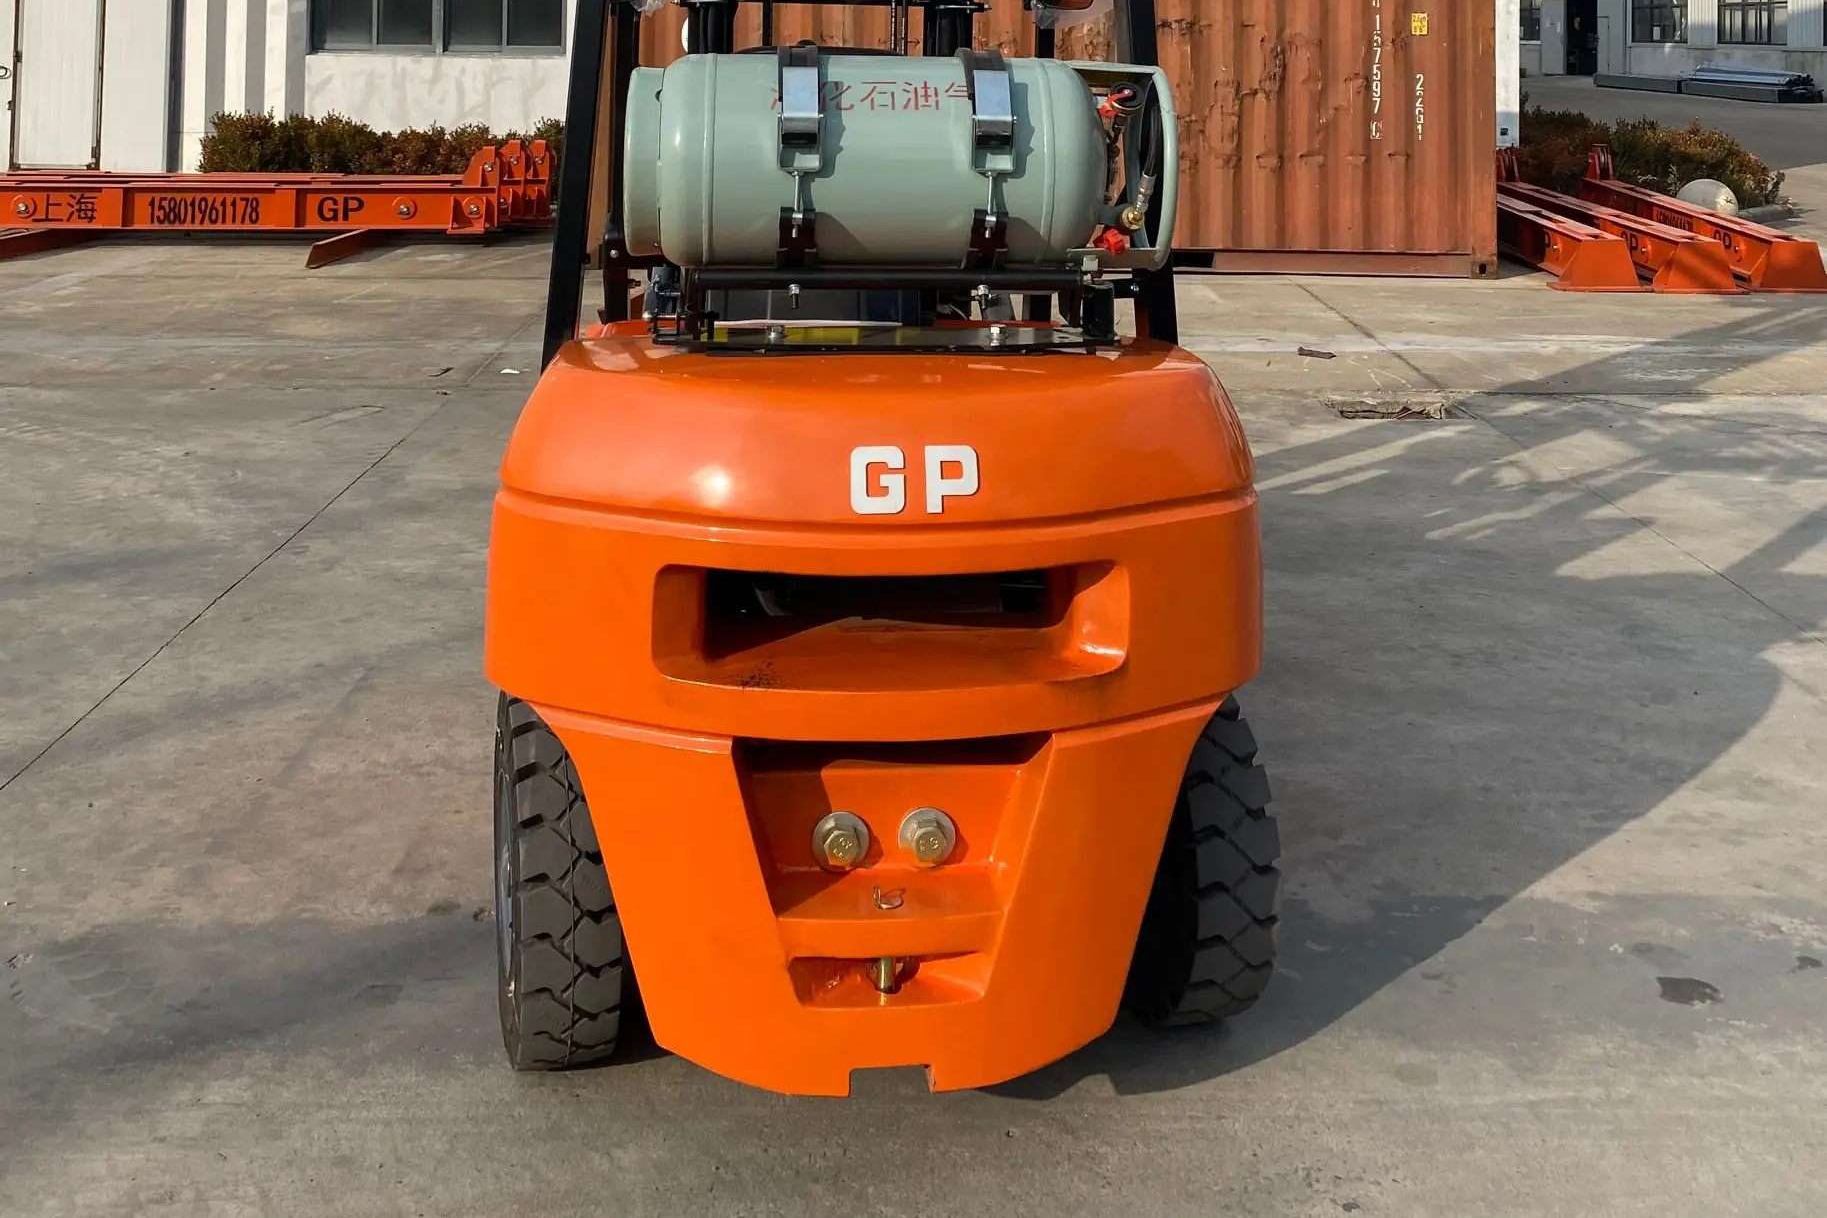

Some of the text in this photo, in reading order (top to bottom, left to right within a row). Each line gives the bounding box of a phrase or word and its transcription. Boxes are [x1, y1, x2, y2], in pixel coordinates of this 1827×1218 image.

[32, 193, 365, 225] 上海 15801961178 GP
[850, 445, 980, 515] GP
